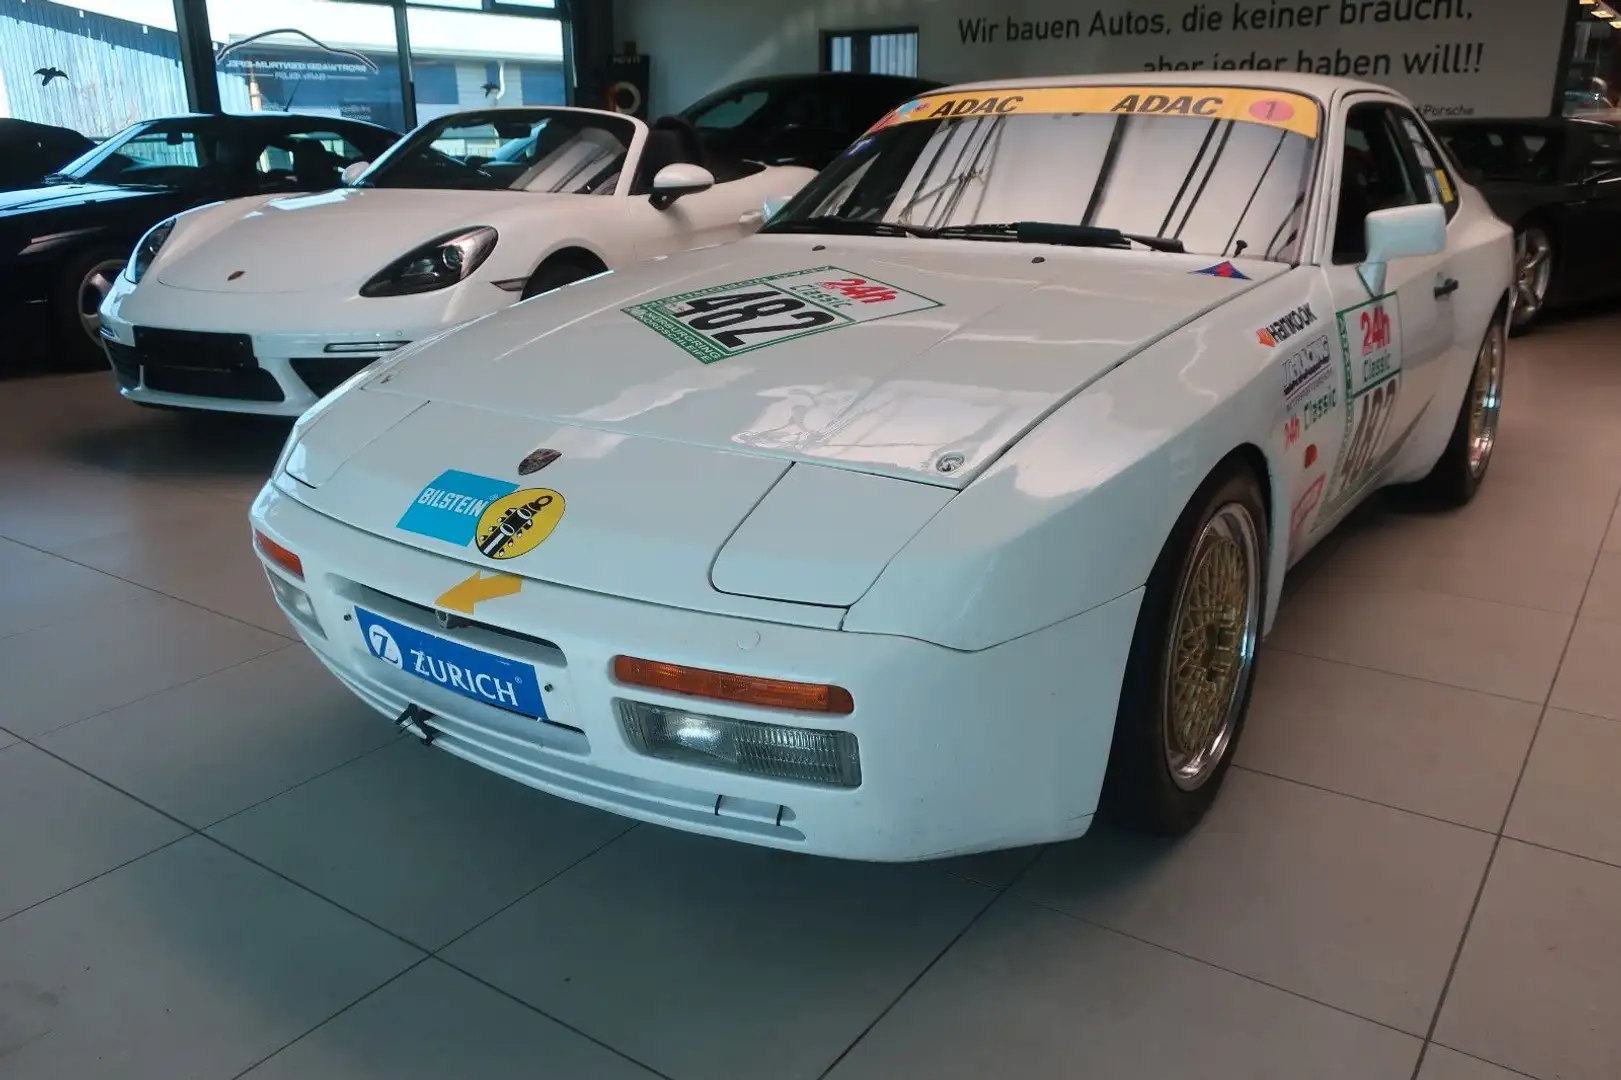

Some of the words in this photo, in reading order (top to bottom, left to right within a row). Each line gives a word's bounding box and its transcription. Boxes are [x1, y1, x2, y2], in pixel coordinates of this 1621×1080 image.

[958, 17, 998, 44] Wir
[1006, 16, 1080, 42] bauen
[1088, 10, 1172, 37] Autos,
[1181, 4, 1222, 33] die
[1232, 2, 1330, 31] keiner
[1297, 48, 1391, 76] haben
[1404, 42, 1484, 75] will!!
[928, 96, 1024, 118] ADAC
[1110, 94, 1224, 117] ADAC
[1424, 103, 1474, 117] Porsche
[819, 277, 899, 304] 24h
[674, 289, 836, 349] 482
[1360, 305, 1392, 357] 24h
[417, 487, 490, 518] BILSTEIN
[410, 648, 520, 708] ZURICH
